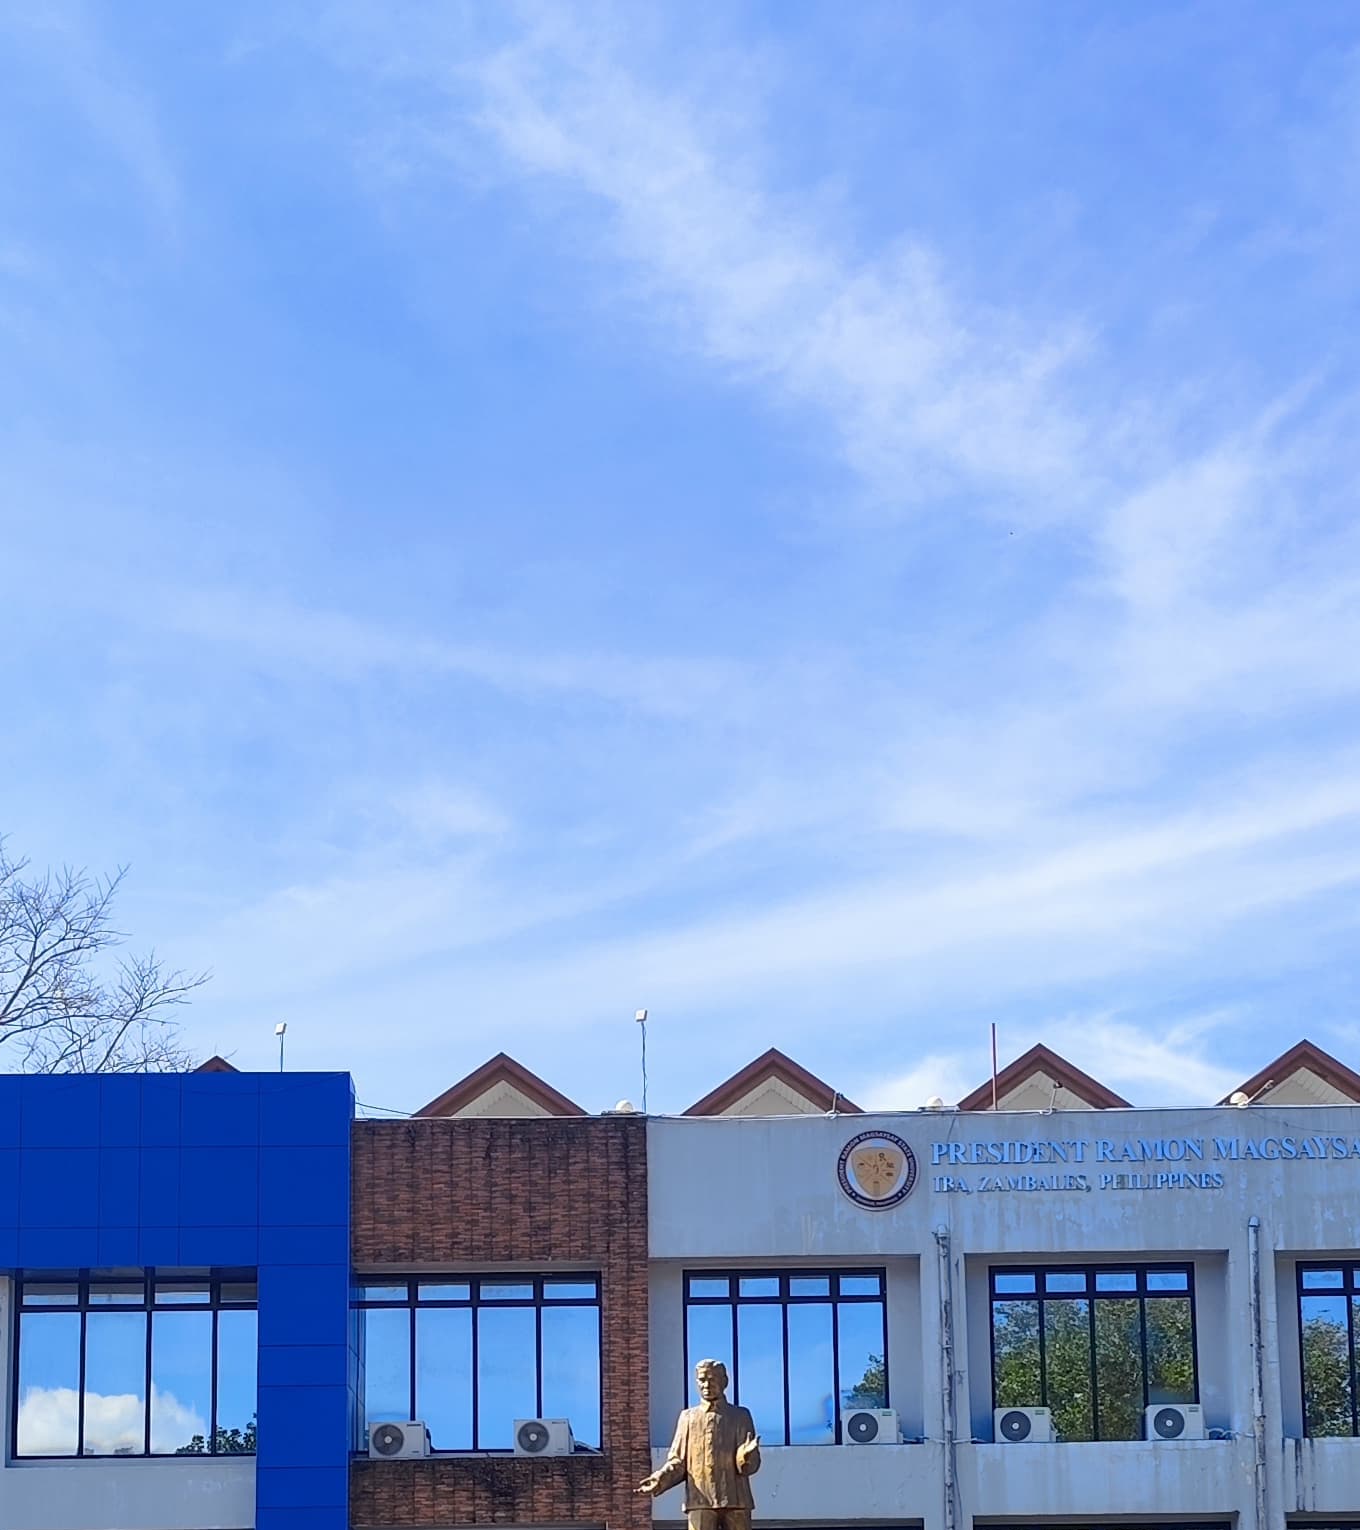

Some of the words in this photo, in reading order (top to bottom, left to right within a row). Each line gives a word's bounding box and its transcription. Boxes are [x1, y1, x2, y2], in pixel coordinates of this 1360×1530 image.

[930, 1140, 1089, 1164] PRESIDENT
[1095, 1137, 1206, 1162] RAMON
[977, 1174, 1092, 1192] ZAMBALES,
[1099, 1173, 1225, 1190] PHILIPPINES
